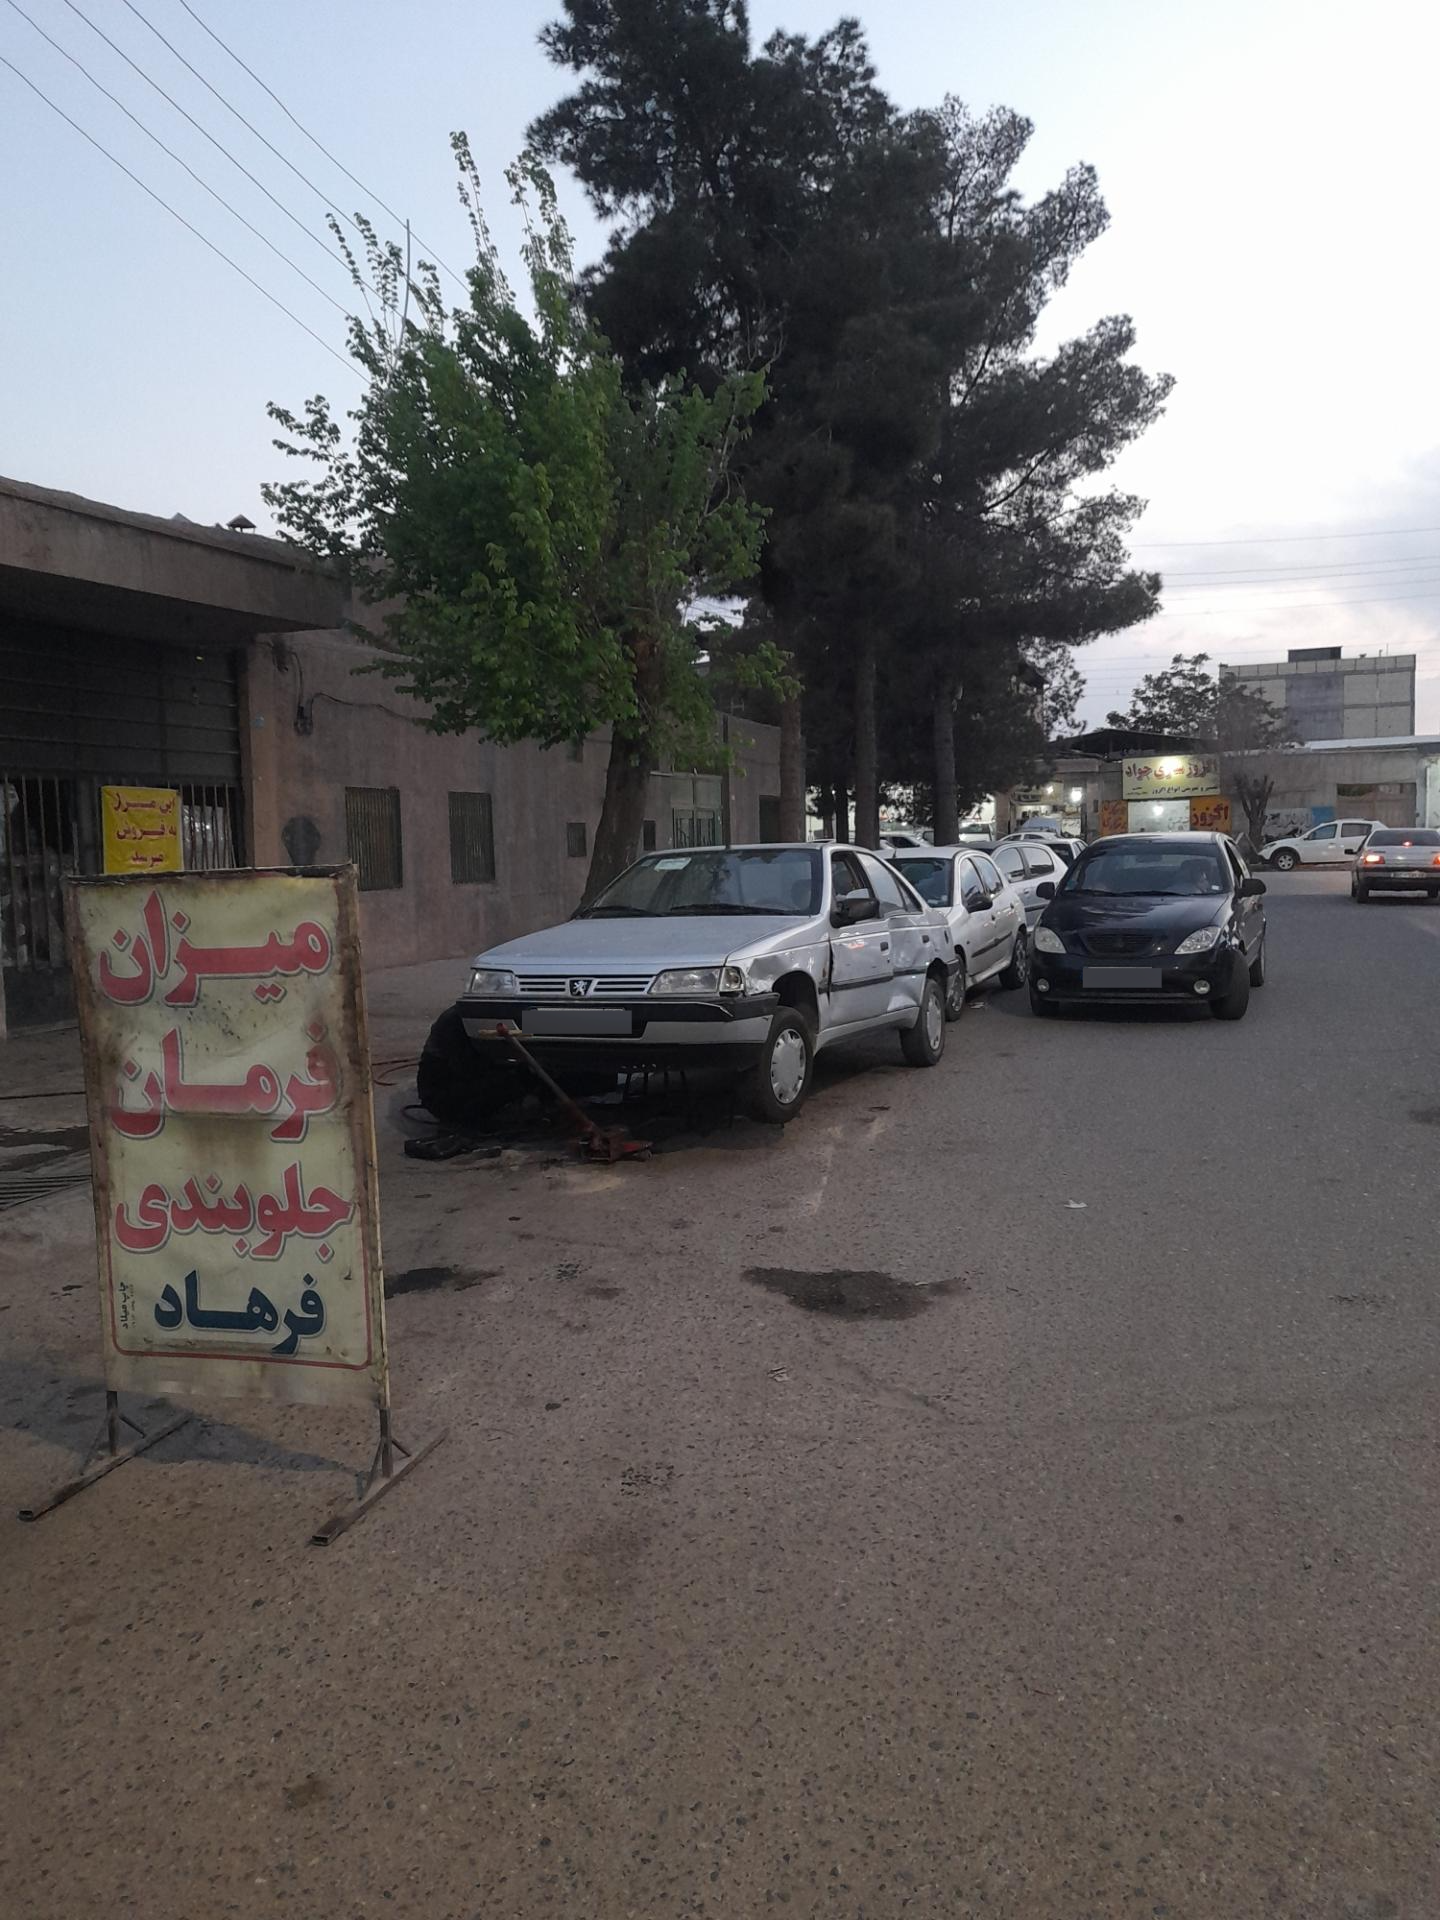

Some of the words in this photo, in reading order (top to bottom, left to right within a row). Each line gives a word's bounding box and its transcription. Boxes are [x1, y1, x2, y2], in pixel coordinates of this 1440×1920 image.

[1125, 762, 1153, 781] جواد
[1153, 764, 1185, 780] سزی
[160, 796, 176, 814] این
[1192, 803, 1229, 827] اگزوز
[116, 819, 166, 840] فروش
[168, 825, 177, 837] به
[98, 889, 333, 1007] میزان
[109, 1020, 342, 1142] فرمان
[114, 1160, 355, 1262] جلوبندی
[118, 1281, 130, 1303] چاپ
[119, 1304, 130, 1330] میلاد
[153, 1269, 326, 1357] فرهاد
